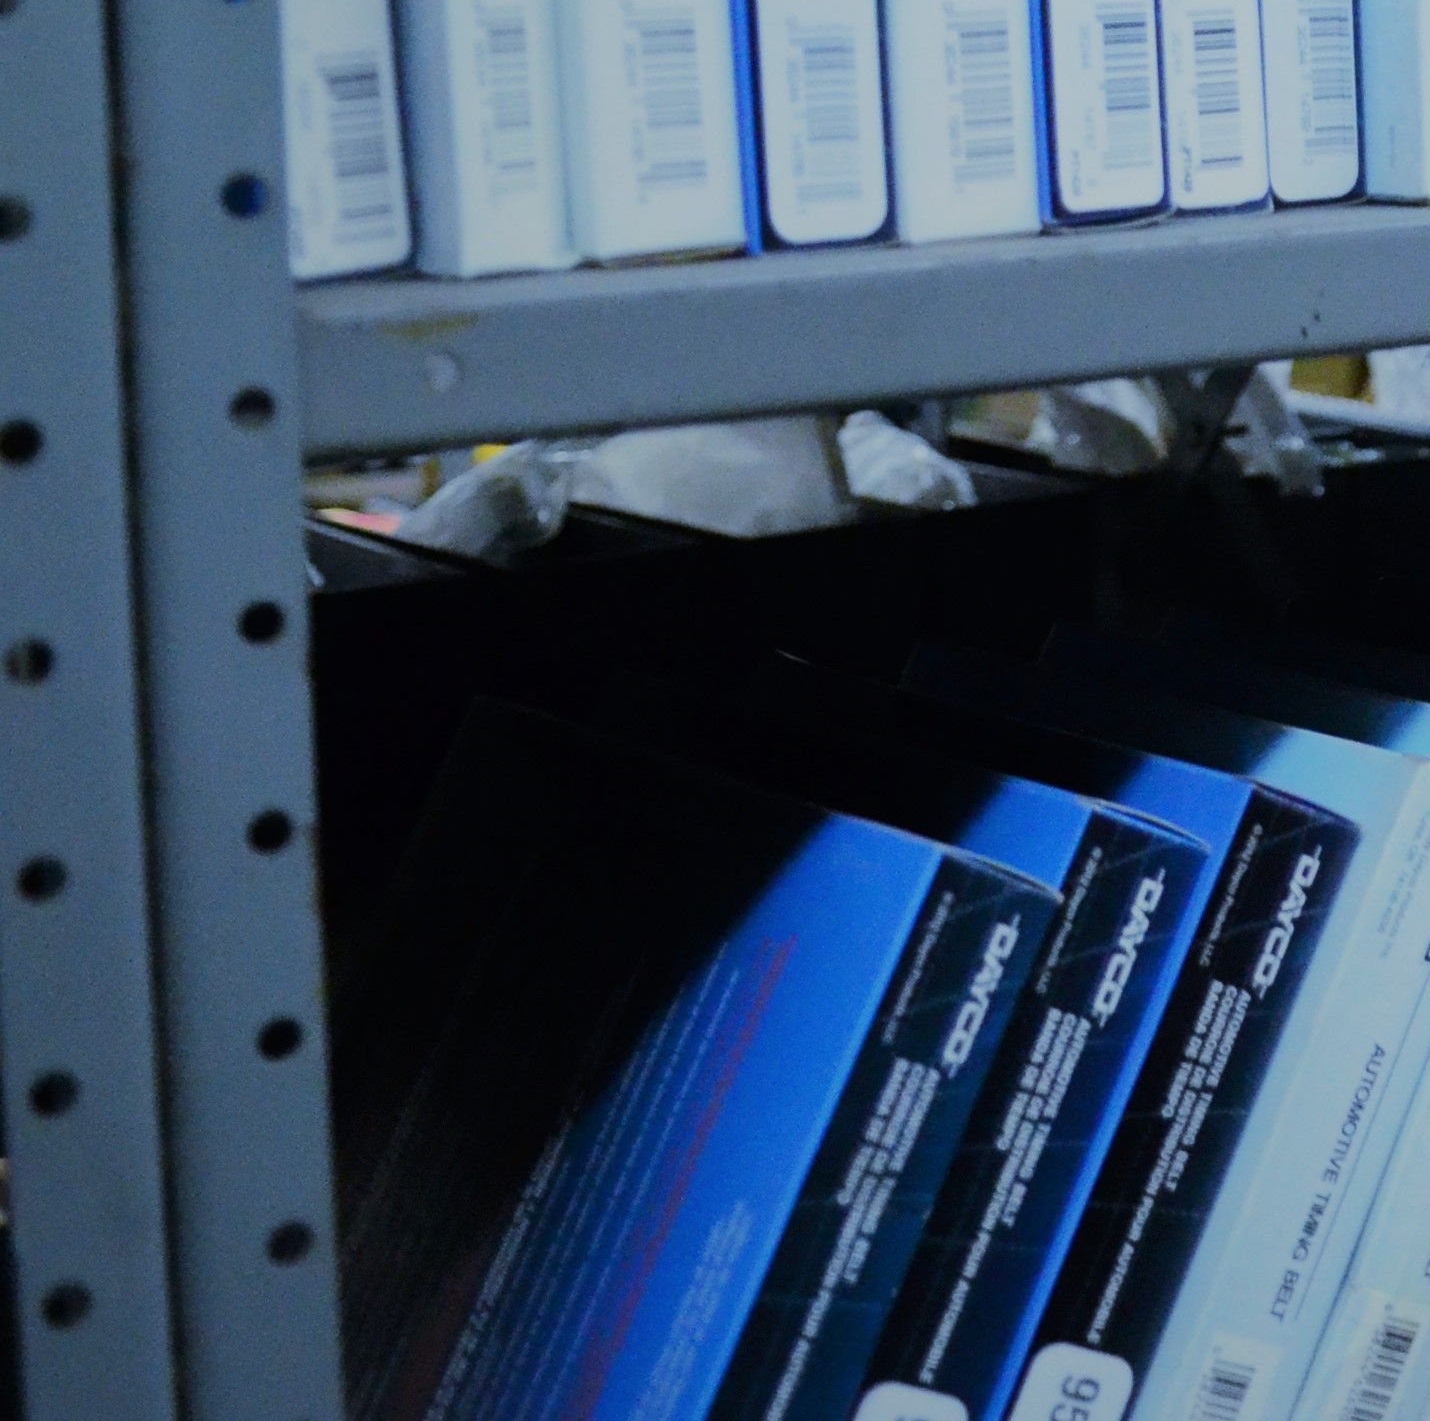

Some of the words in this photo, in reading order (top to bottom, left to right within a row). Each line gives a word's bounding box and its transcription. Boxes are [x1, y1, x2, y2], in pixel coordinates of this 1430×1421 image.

[1091, 875, 1167, 1017] DAYCO
[1251, 853, 1321, 992] DAYCO
[942, 921, 1018, 1065] DAYCO
[1320, 1043, 1388, 1183] AUTOMOTIVE
[1266, 1269, 1300, 1321] BELT
[1290, 1191, 1334, 1262] TIMING
